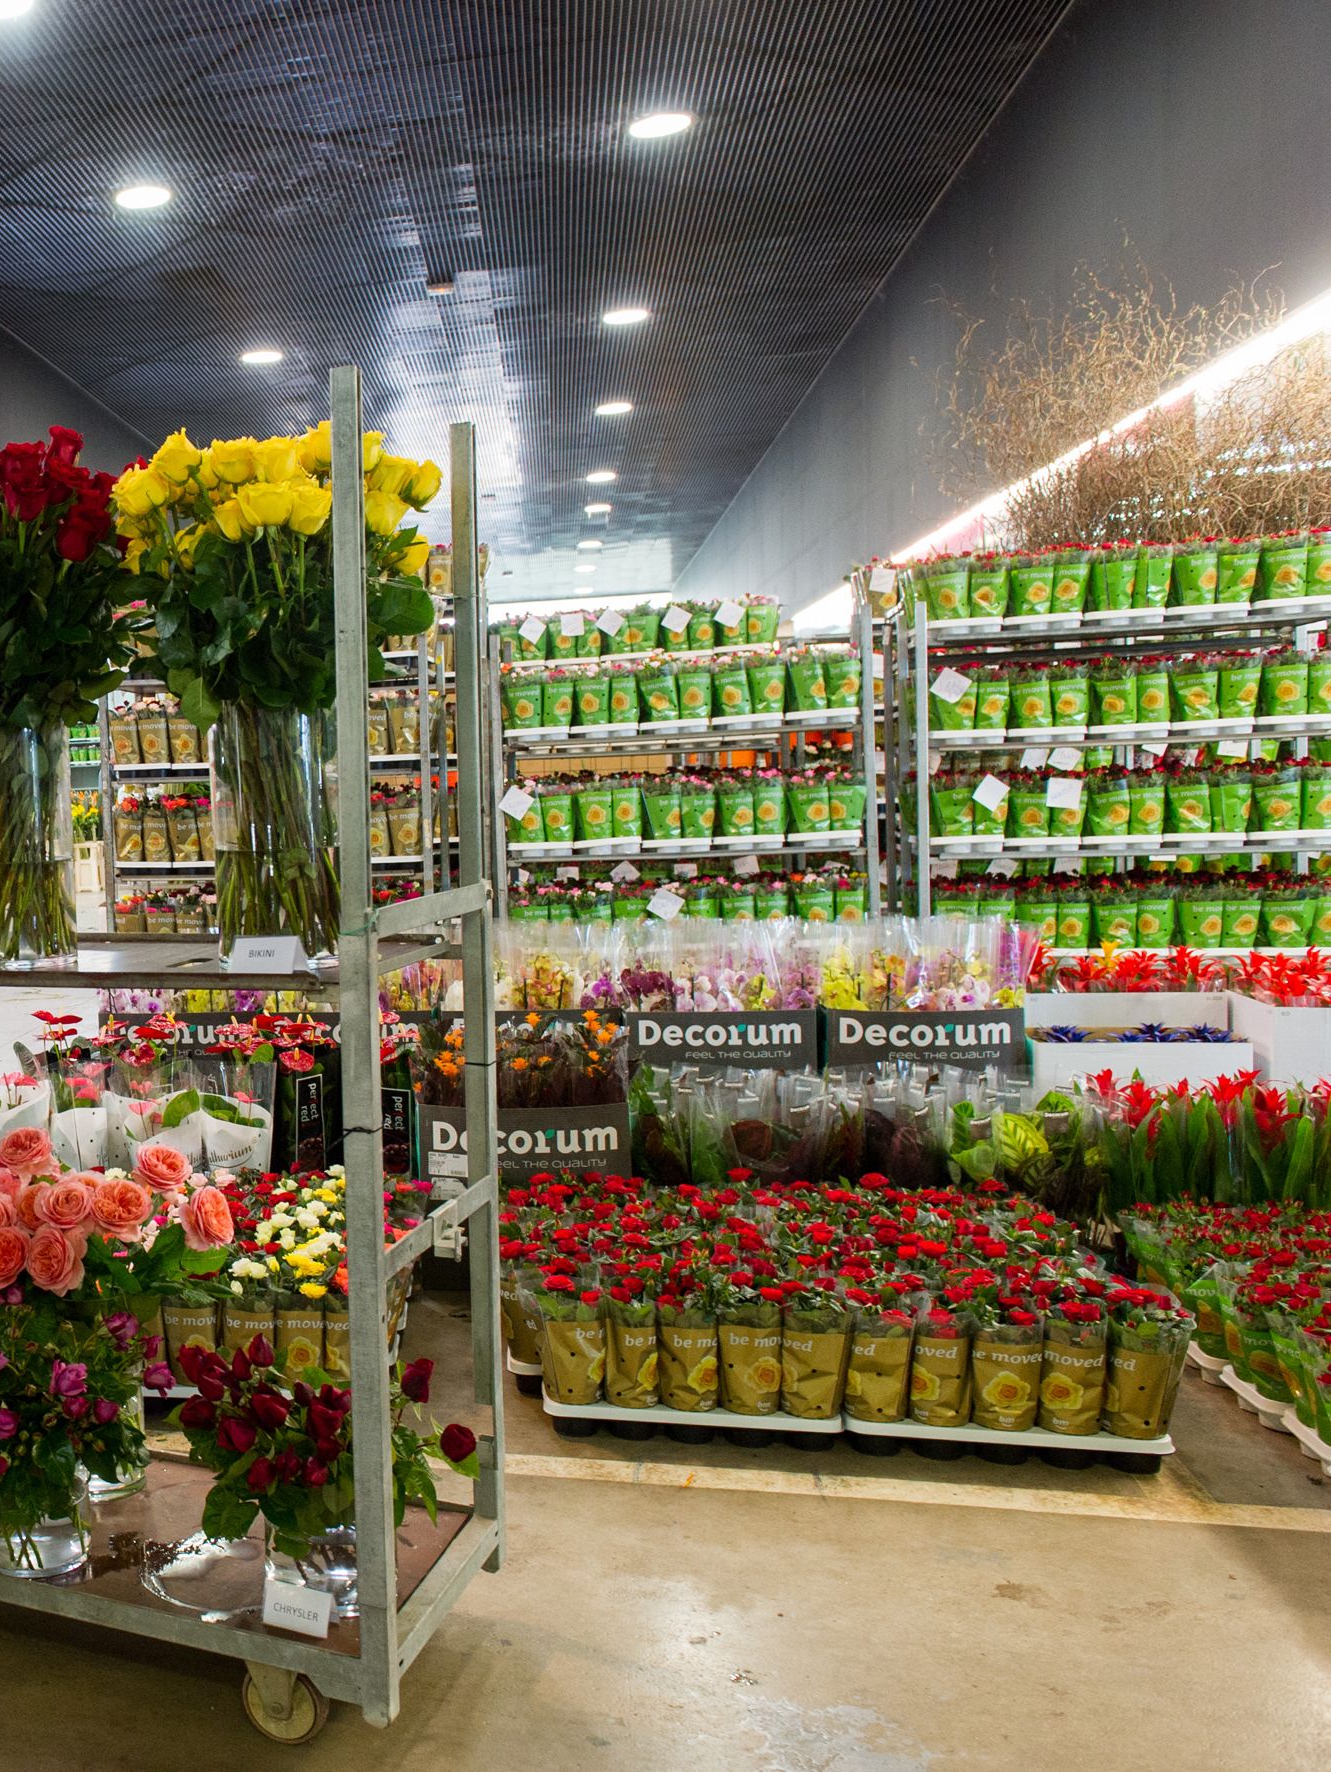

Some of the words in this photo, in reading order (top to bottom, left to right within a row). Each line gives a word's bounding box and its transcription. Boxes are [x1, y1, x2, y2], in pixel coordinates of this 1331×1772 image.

[248, 949, 275, 958] BIKINI
[638, 1020, 802, 1046] Decorum
[839, 1016, 1011, 1047] Decorum
[164, 1313, 179, 1326] be
[226, 1315, 241, 1328] be
[624, 1334, 643, 1346] be
[673, 1334, 692, 1348] be
[729, 1332, 749, 1346] be
[1044, 1349, 1105, 1368] moved
[273, 1602, 319, 1622] CHRYSLER
